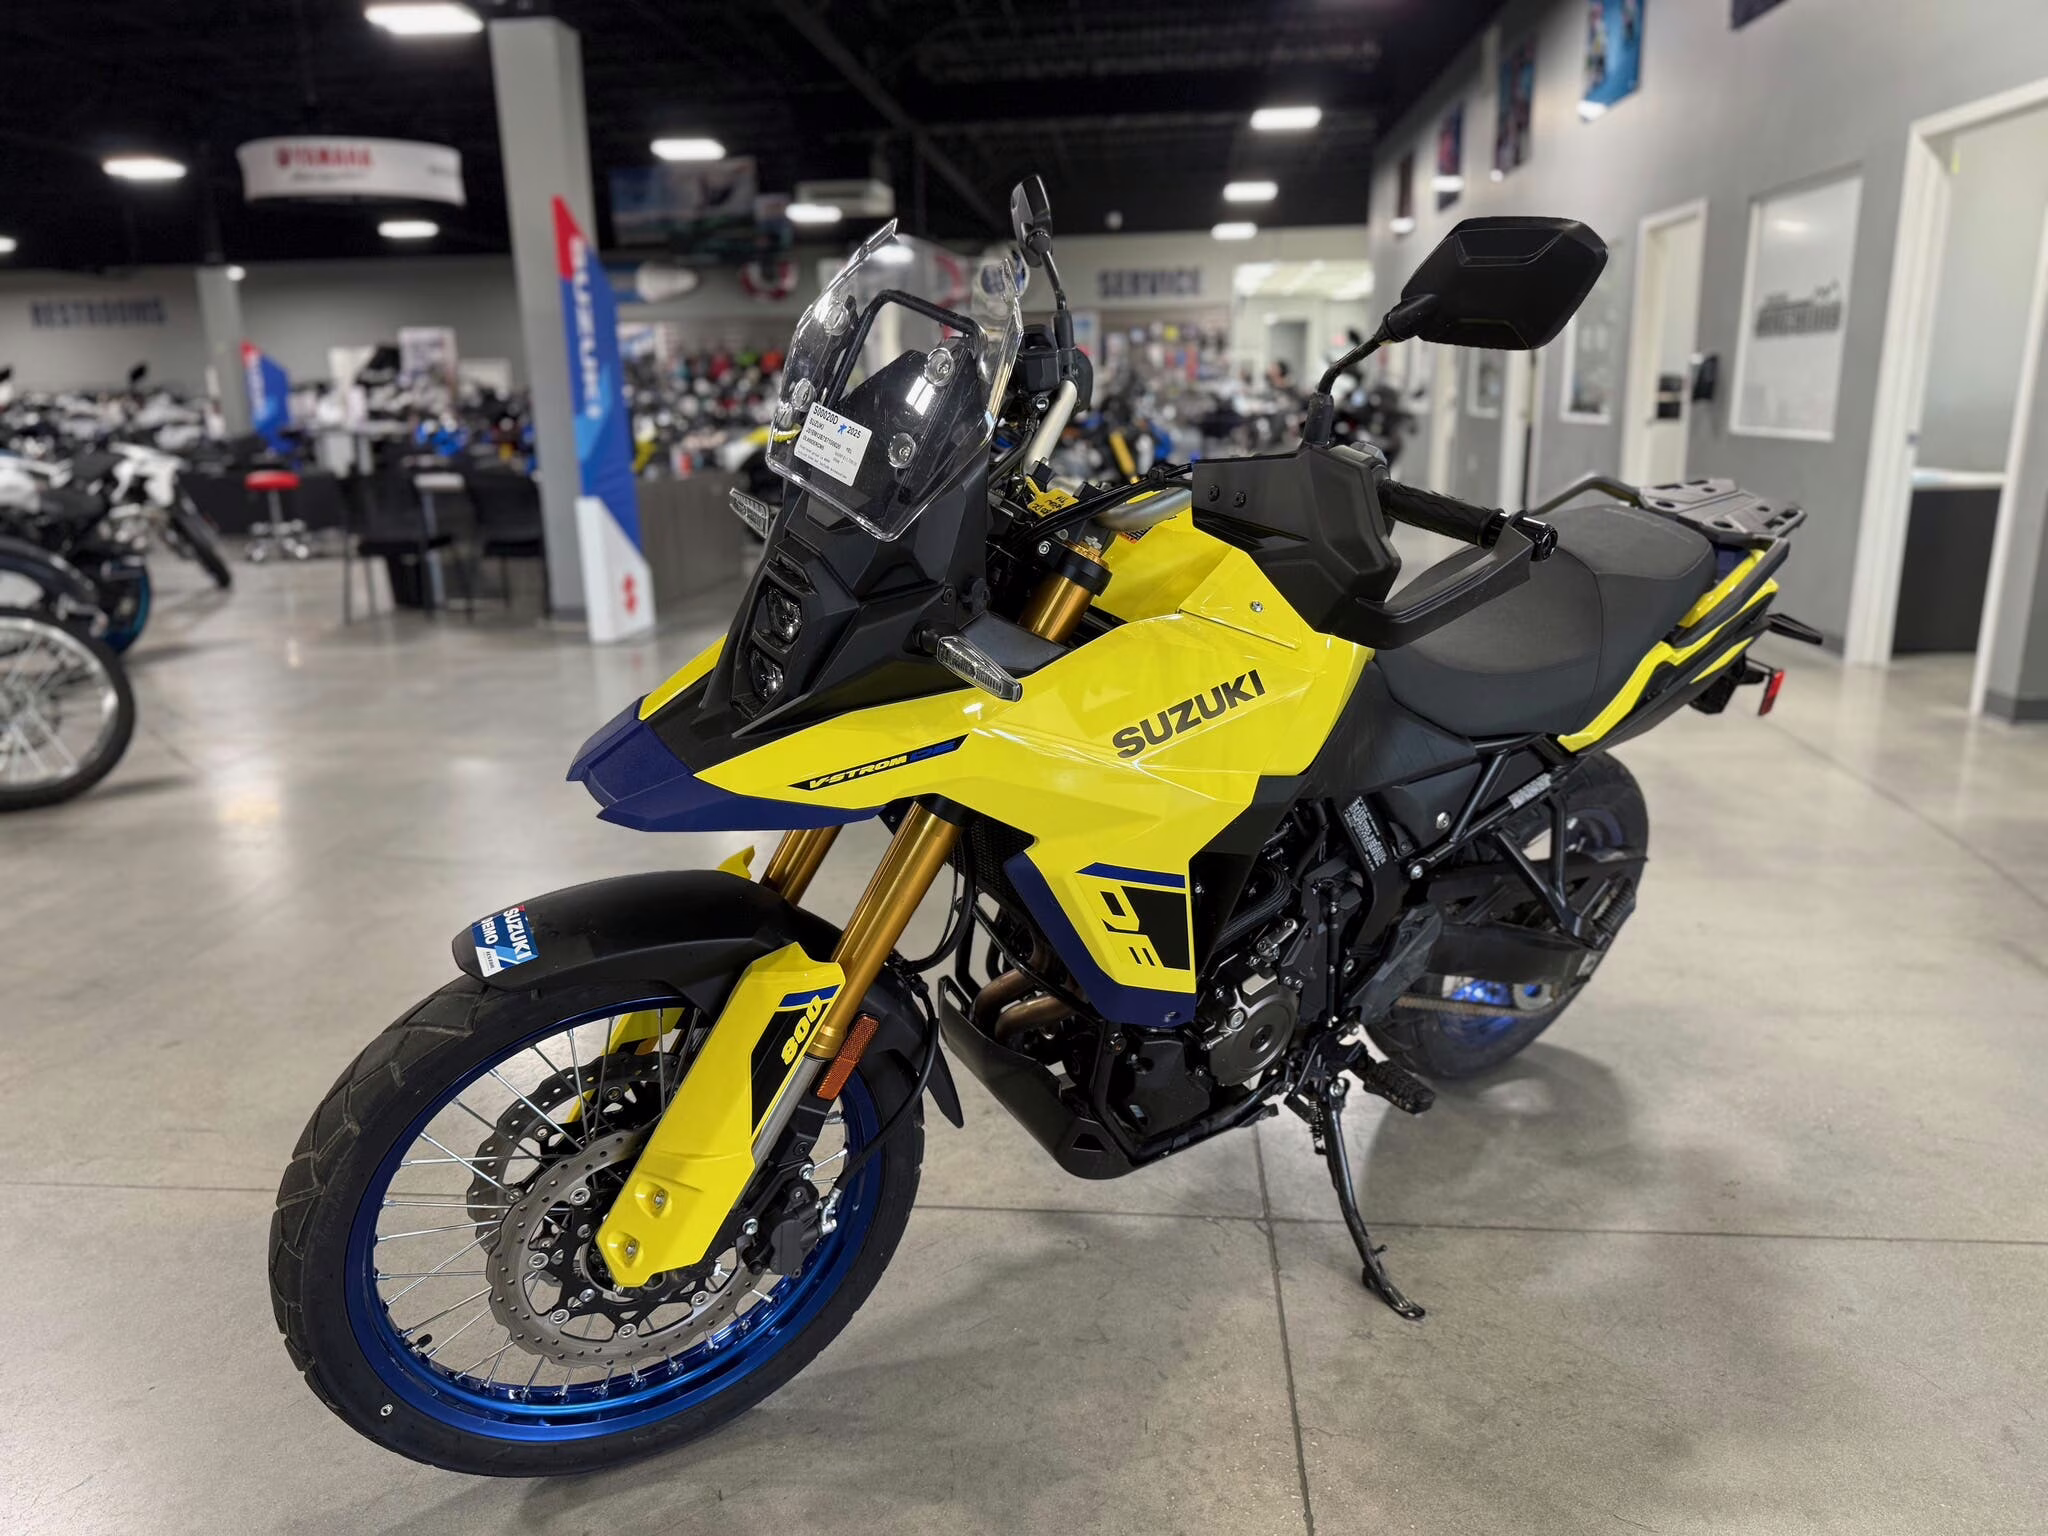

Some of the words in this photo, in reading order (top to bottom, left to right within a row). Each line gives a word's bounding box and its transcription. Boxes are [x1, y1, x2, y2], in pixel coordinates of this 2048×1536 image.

[1099, 269, 1202, 296] SERVICE
[30, 298, 166, 328] RESTROOMS
[847, 426, 862, 439] 2025
[1113, 669, 1266, 759] SUZUKI
[809, 755, 908, 789] V-STROM
[503, 907, 533, 961] SUZUKI
[781, 994, 823, 1066] 800
